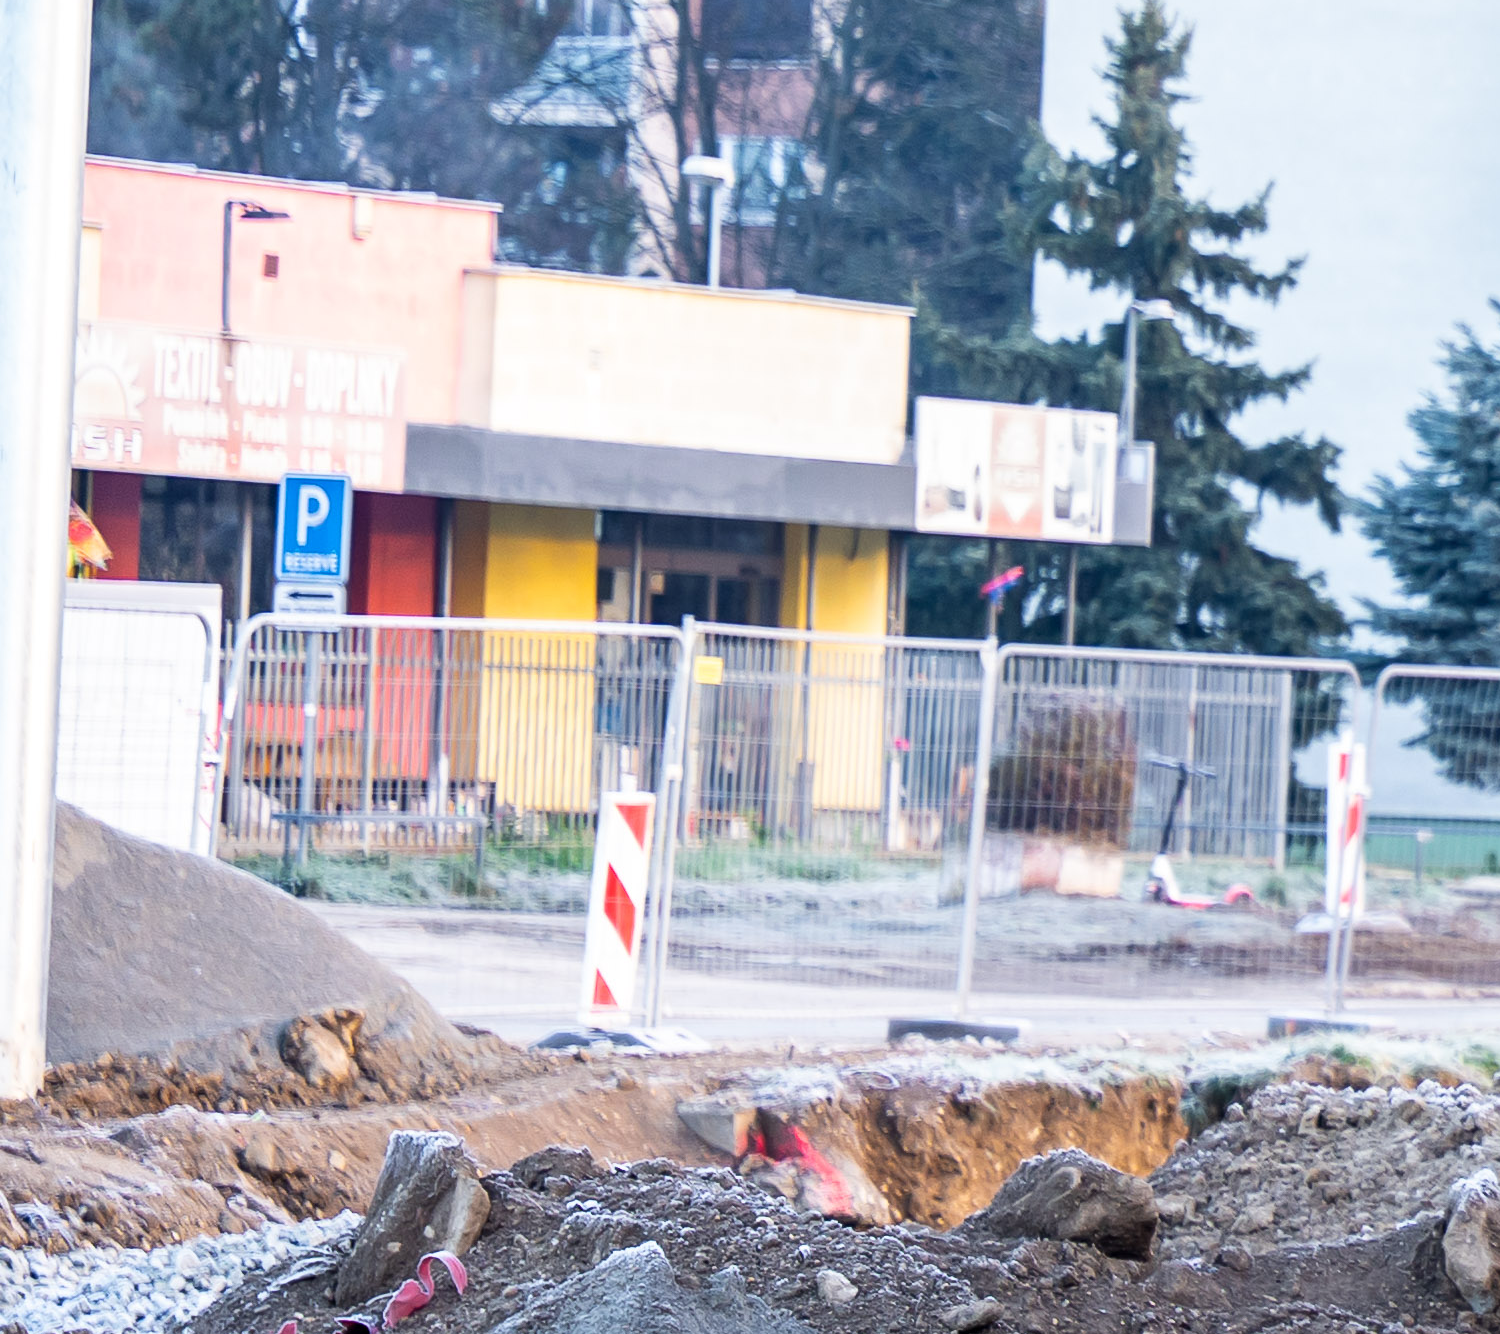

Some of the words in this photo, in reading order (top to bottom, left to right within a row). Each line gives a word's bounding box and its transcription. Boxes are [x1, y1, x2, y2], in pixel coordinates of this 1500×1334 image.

[154, 335, 222, 404] TEXTIL
[235, 342, 294, 408] OBUV
[296, 484, 331, 547] P
